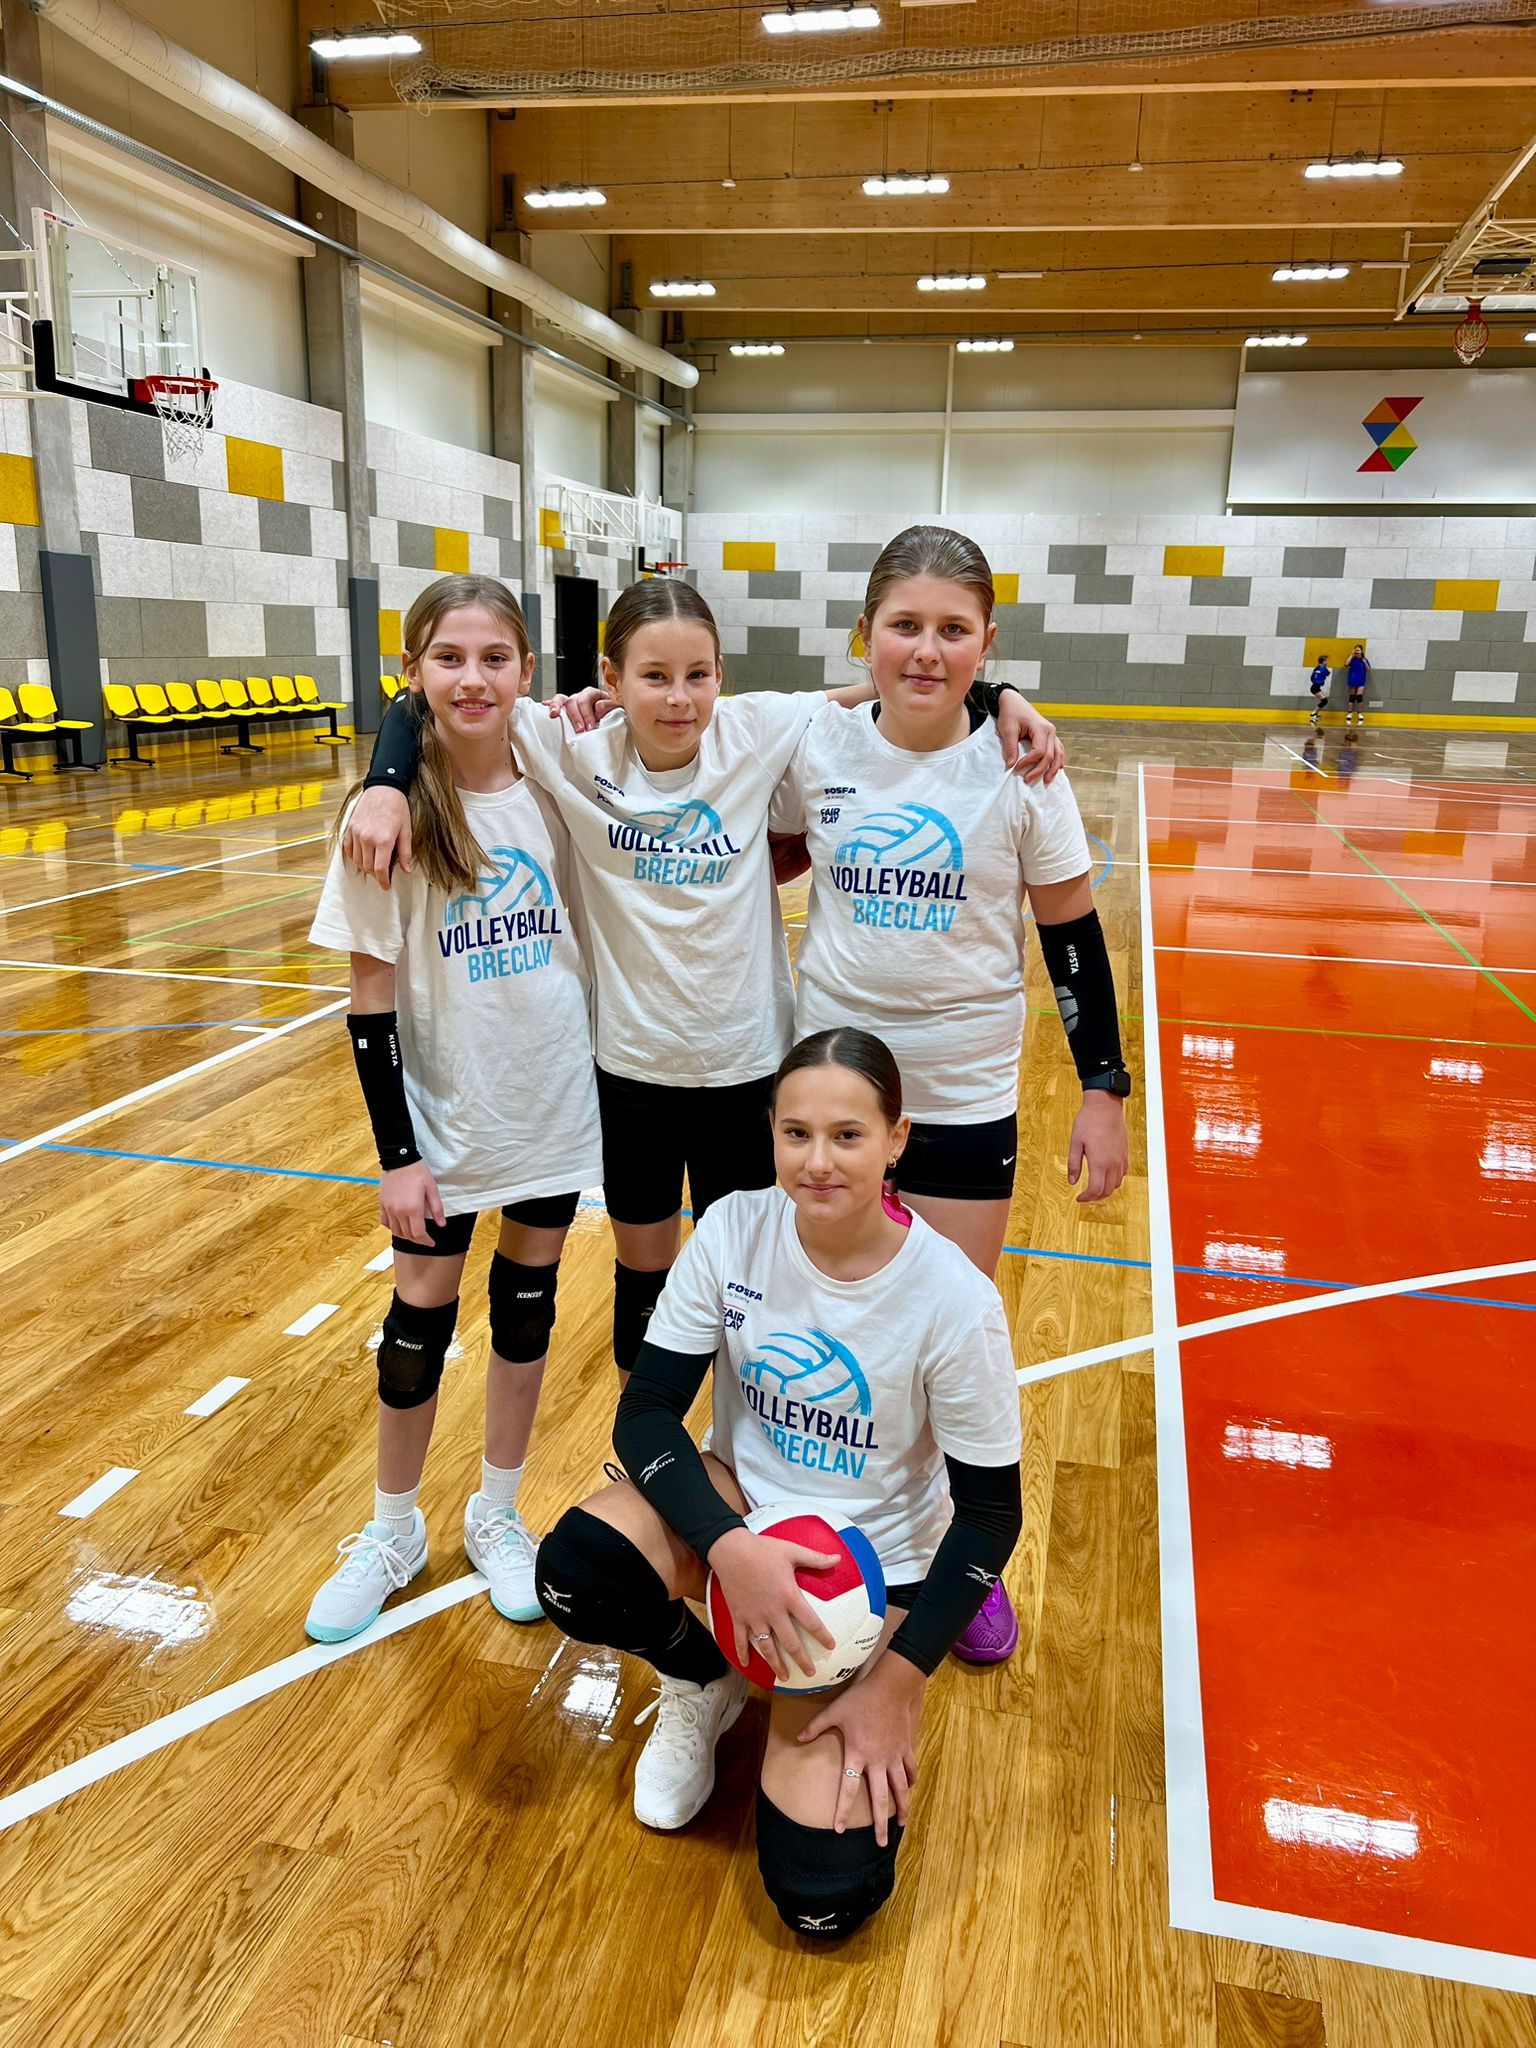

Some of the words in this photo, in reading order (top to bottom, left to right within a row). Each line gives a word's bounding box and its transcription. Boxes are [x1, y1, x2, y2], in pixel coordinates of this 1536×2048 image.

[824, 786, 857, 795] FOSFA
[820, 808, 841, 817] FAIR
[820, 815, 840, 824] PLAY
[633, 853, 732, 886] BŘECLAV
[829, 865, 968, 901] VOLLEYBALL
[852, 894, 956, 932] BŘECLAV
[437, 908, 562, 958] VOLLEYBALL
[467, 938, 553, 984] BŘECLAV
[1066, 944, 1079, 975] KIPSTA
[388, 1034, 399, 1067] KIPSTA
[516, 1290, 544, 1299] KENSIS
[726, 1281, 763, 1302] FOSFA
[723, 1318, 744, 1331] LAY
[395, 1338, 424, 1351] KENSIS
